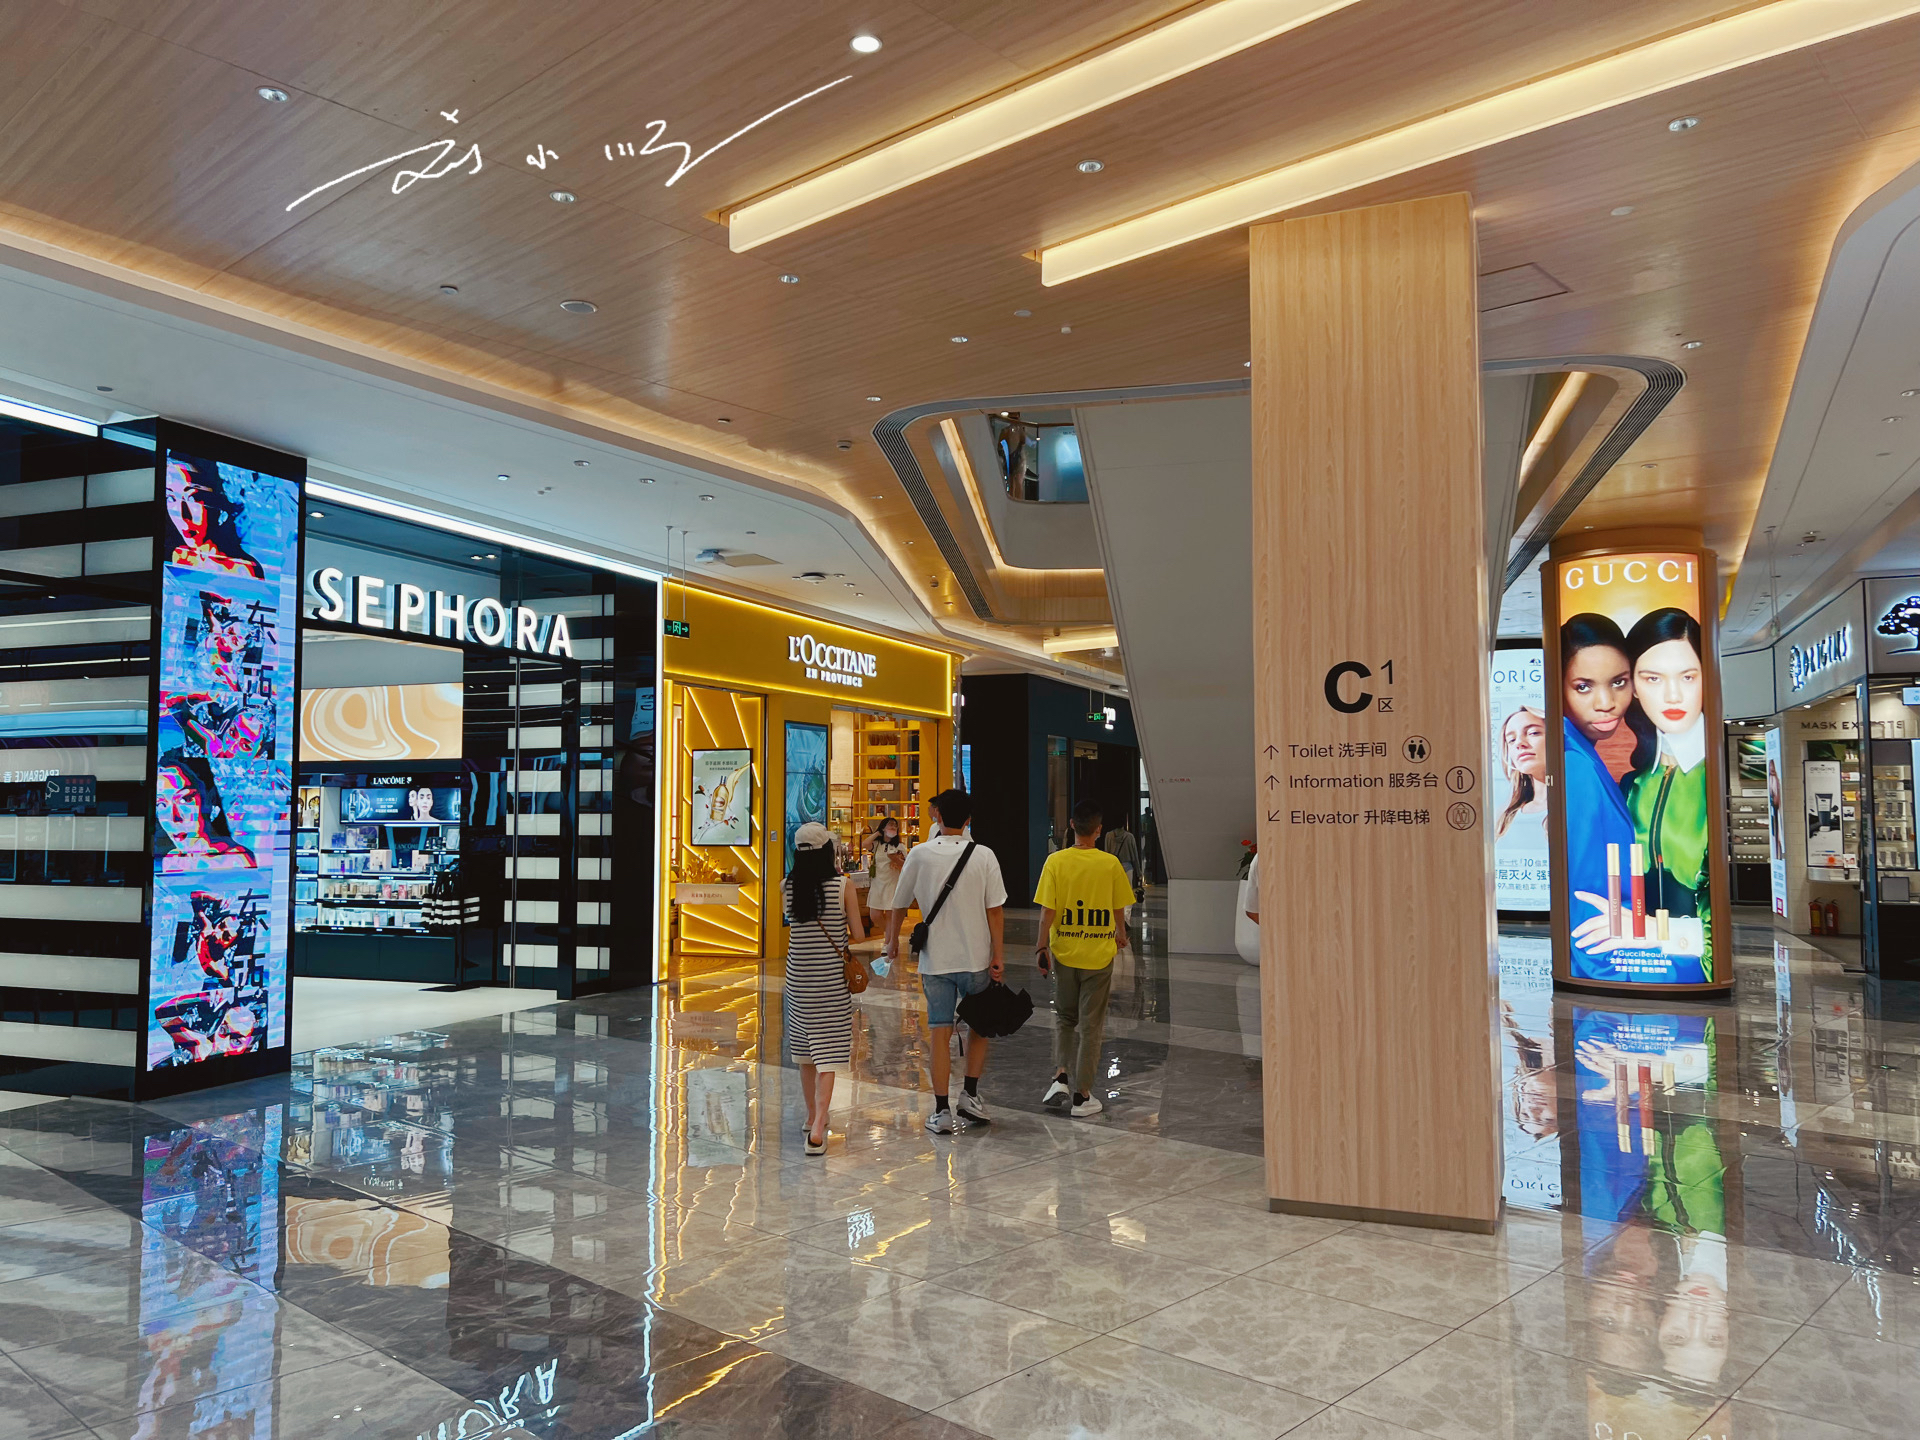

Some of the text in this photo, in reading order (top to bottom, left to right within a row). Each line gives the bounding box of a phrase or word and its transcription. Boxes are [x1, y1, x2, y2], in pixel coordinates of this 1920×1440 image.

[1565, 560, 1693, 590] GUCCI
[314, 567, 573, 658] SEPHORA
[788, 634, 877, 678] L'OCCITANE
[1803, 626, 1848, 677] ORIGINS
[806, 667, 863, 688] EN PROVENCE
[1378, 697, 1394, 713] 区
[1801, 721, 1838, 730] MASK
[1289, 742, 1387, 758] Toilet 洗手间
[373, 776, 406, 785] LANCÔME
[1289, 772, 1439, 788] Information 服务台
[1291, 809, 1431, 825] Elevator 升降电梯
[1061, 899, 1110, 926] aim
[1613, 950, 1668, 959] #GucciBeauty
